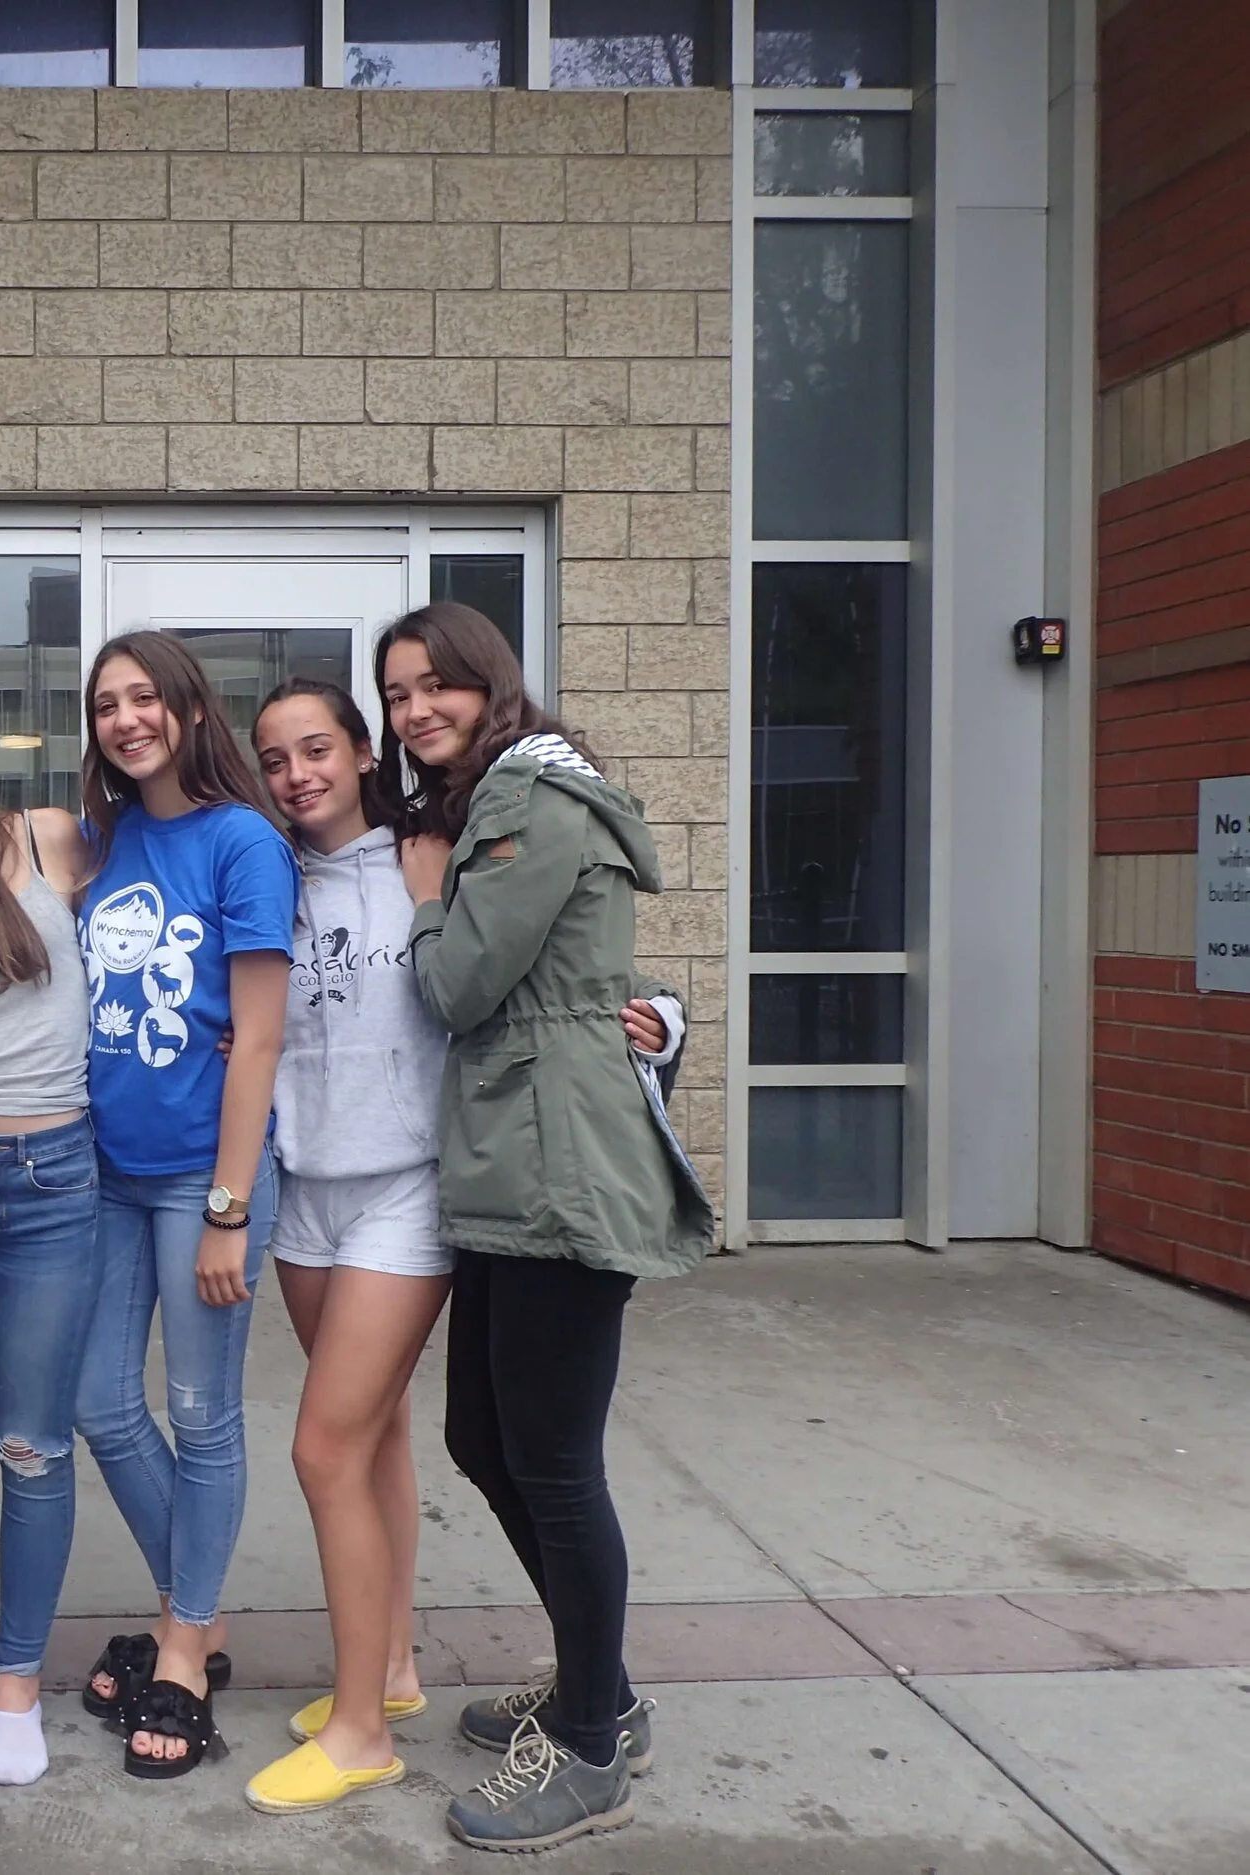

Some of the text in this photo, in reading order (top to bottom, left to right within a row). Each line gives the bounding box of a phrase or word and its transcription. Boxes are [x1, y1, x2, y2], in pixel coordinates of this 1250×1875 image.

[1215, 814, 1241, 834] No
[1217, 846, 1250, 868] withi
[96, 922, 154, 938] Wynchemna
[1208, 943, 1227, 957] NO
[95, 1045, 119, 1054] CANADA
